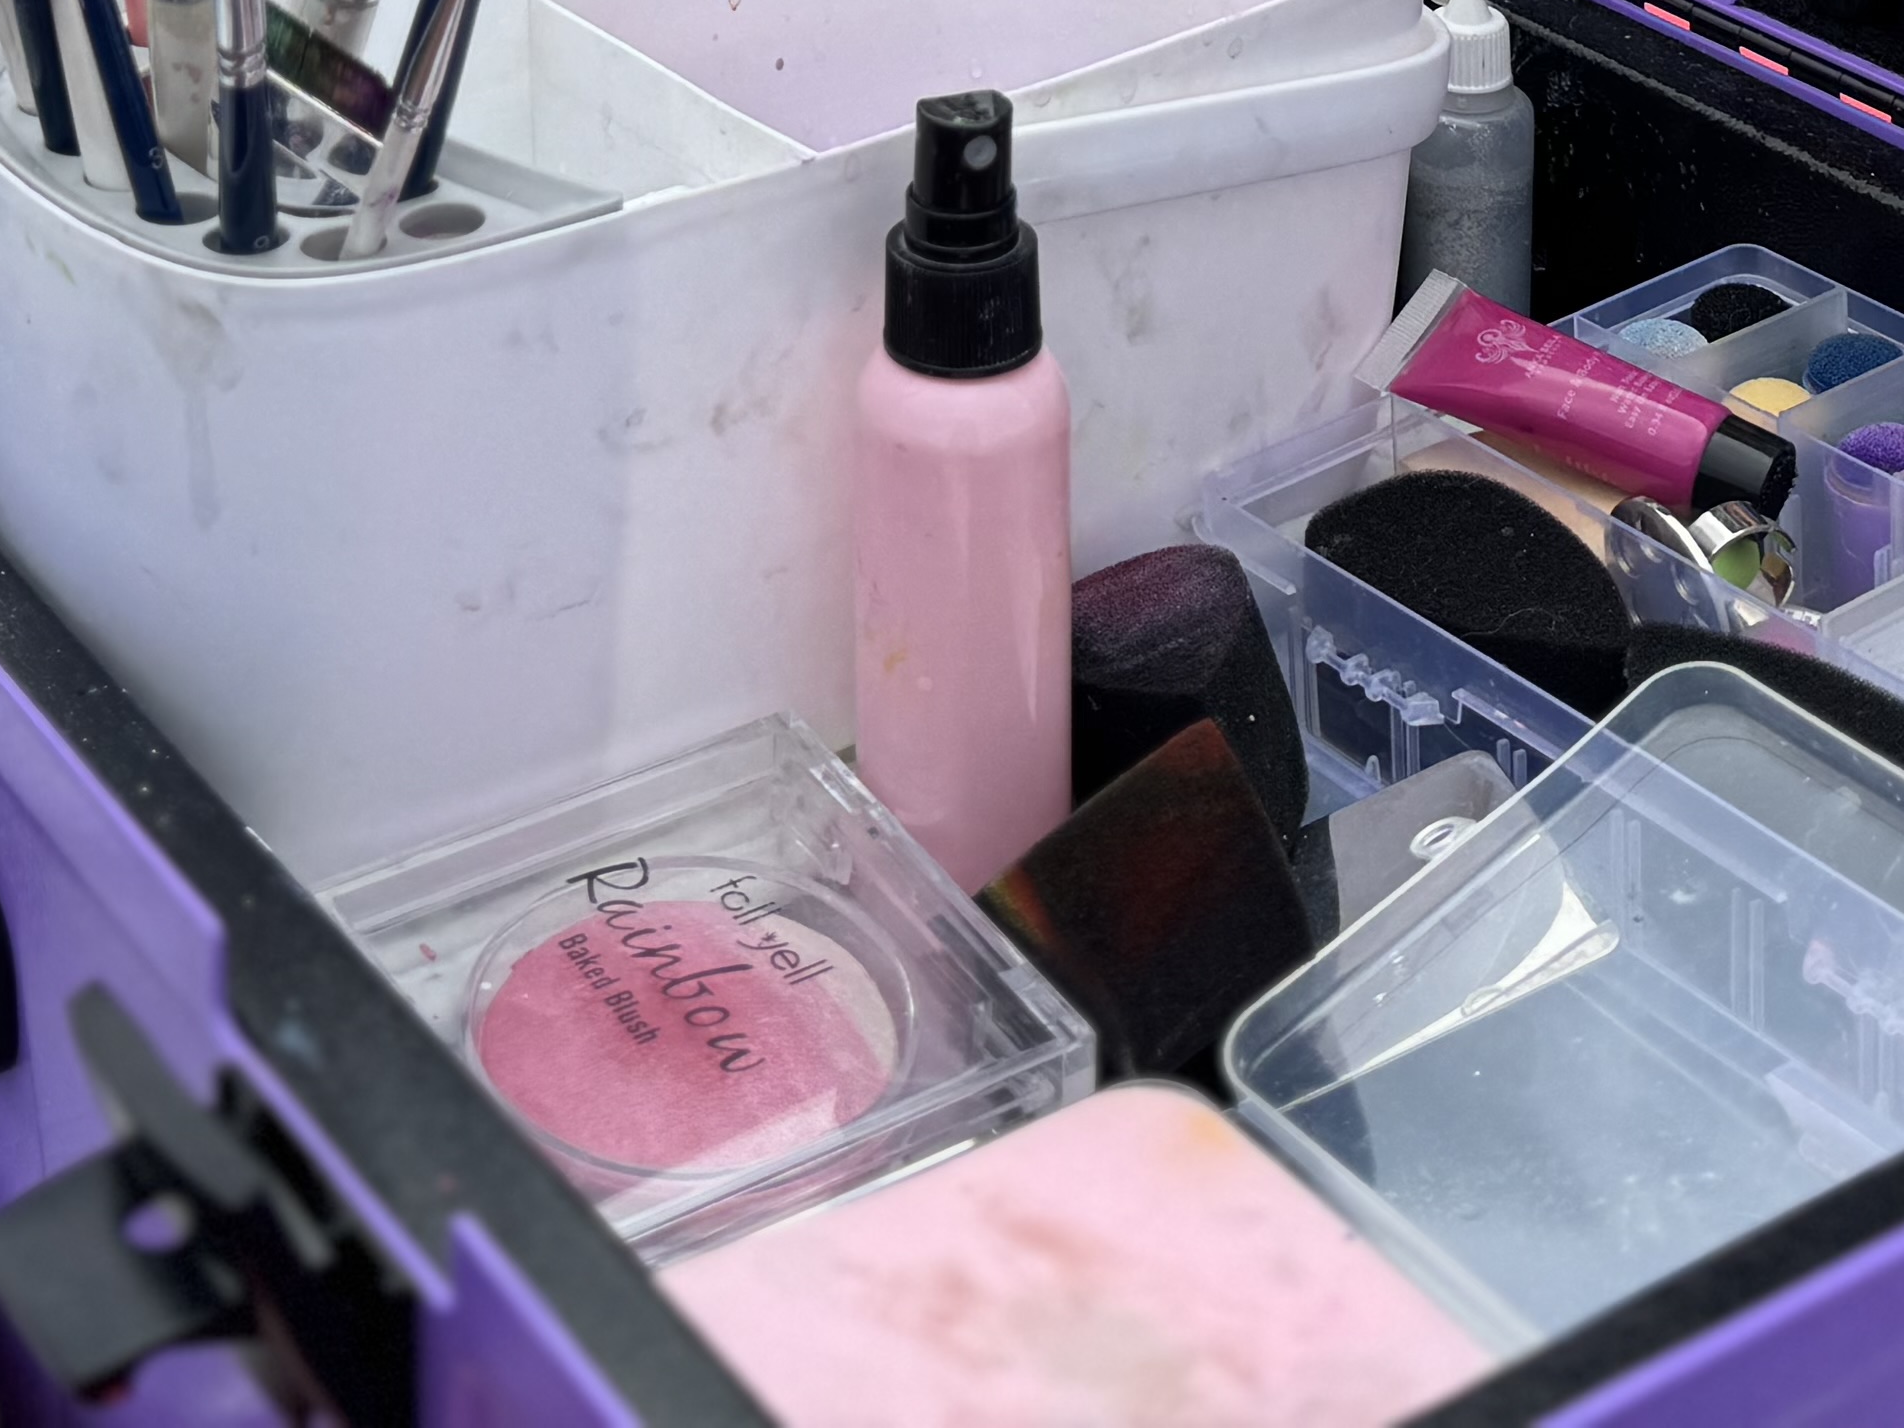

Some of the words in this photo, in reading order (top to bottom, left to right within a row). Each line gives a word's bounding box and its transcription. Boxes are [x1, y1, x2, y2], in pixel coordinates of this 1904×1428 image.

[1557, 389, 1577, 420] Face
[558, 933, 621, 990] Baked
[603, 989, 661, 1045] Blush
[566, 857, 766, 1072] Rainbow
